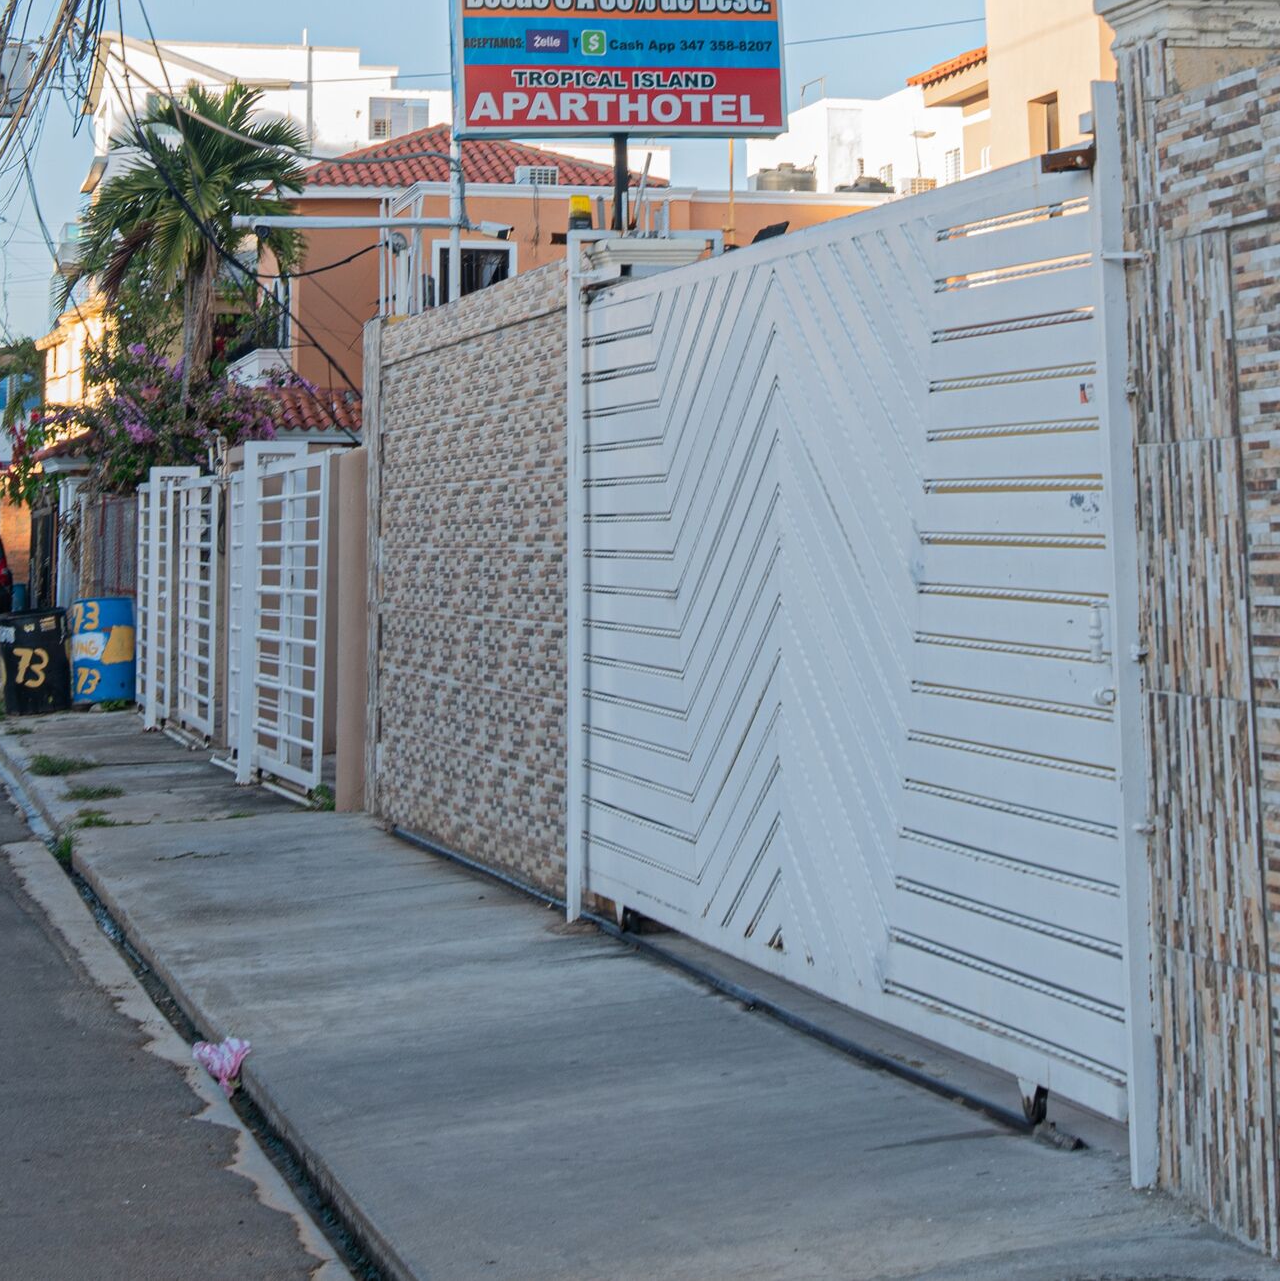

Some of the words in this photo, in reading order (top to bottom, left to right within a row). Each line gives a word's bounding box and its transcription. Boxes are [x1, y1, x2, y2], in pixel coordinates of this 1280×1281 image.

[464, 37, 525, 48] ACEPTAMOS:
[534, 35, 561, 48] Zelle
[573, 37, 579, 48] Y
[610, 39, 644, 51] Cash
[648, 40, 675, 53] App
[680, 40, 704, 51] 347
[710, 40, 772, 52] 358-8207
[513, 71, 627, 88] TROPICAL
[633, 73, 715, 89] ISLAND
[470, 92, 764, 123] APARTHOTEL
[73, 602, 100, 633] 73
[13, 648, 49, 688] 73
[77, 668, 100, 694] 73
